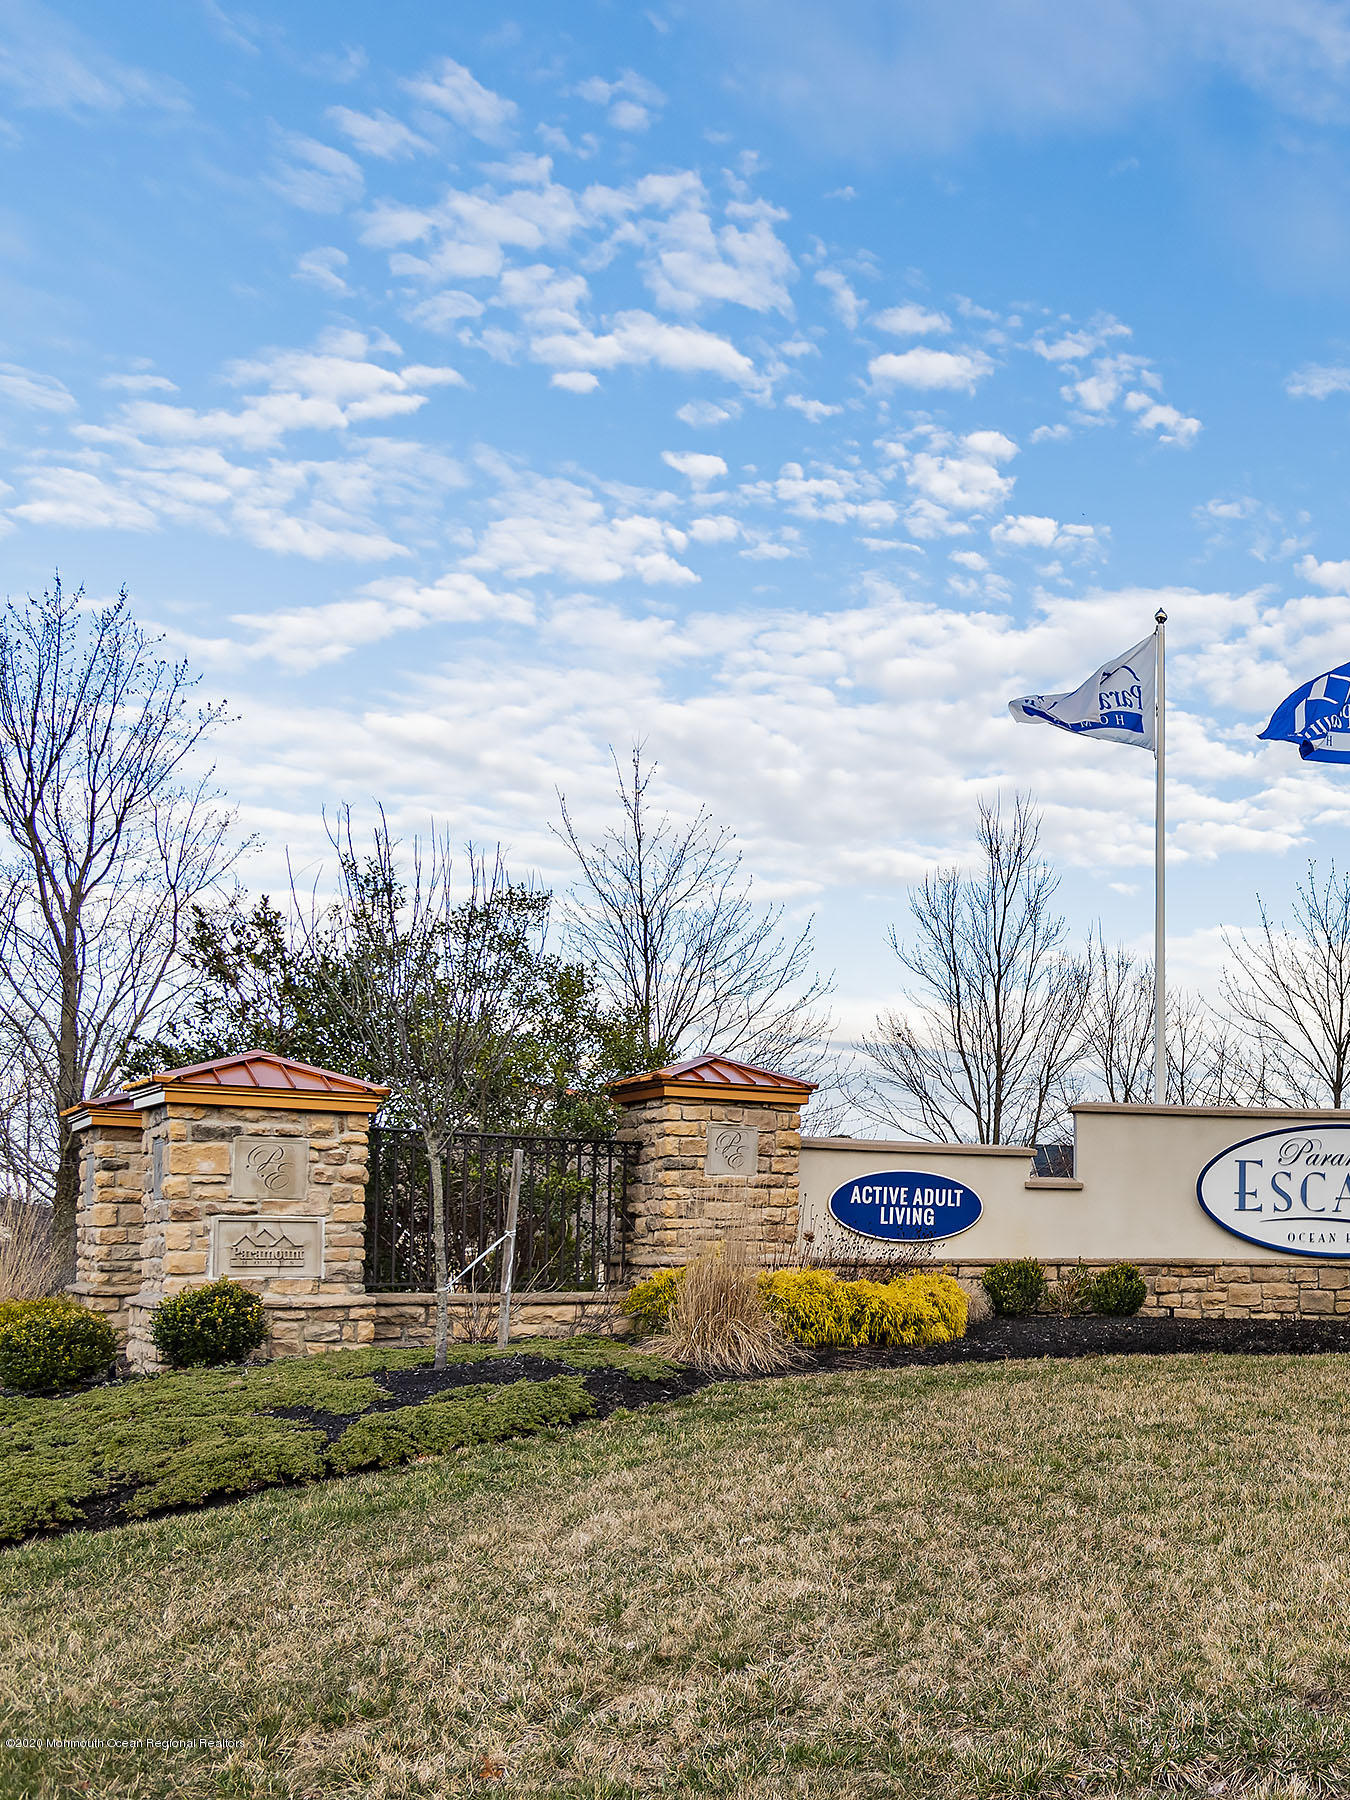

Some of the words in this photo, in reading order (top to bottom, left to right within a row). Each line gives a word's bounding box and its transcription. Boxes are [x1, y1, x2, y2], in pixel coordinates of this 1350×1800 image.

[850, 1185, 909, 1205] ACTIVE
[912, 1188, 963, 1207] ADULT
[880, 1206, 935, 1226] LIVING
[1287, 1232, 1337, 1244] OCEAN
